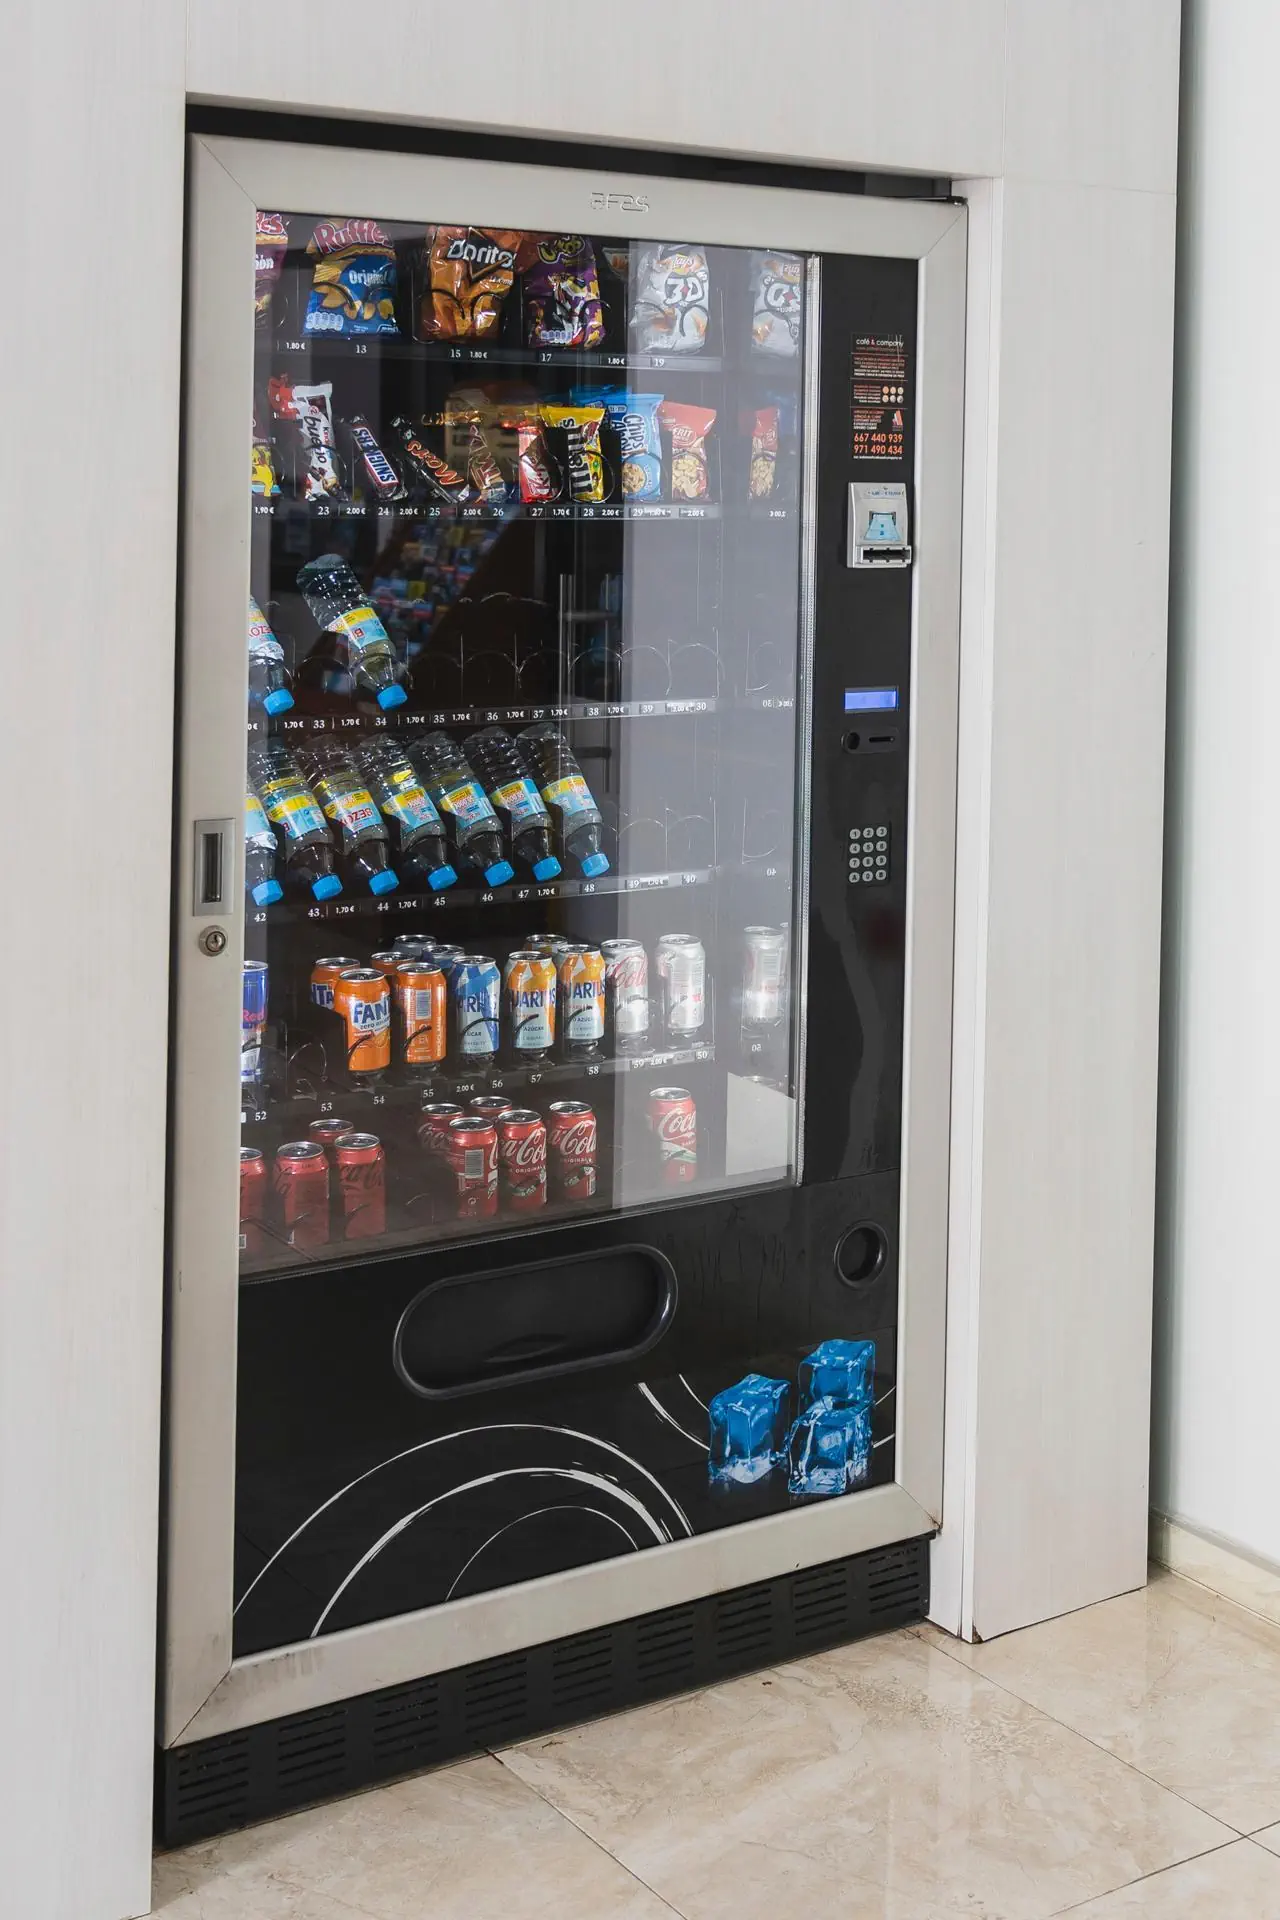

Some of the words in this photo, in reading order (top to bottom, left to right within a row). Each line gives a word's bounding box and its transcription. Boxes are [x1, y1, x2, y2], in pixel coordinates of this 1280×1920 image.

[313, 218, 393, 254] Ruffle
[446, 238, 515, 269] Dorito
[876, 340, 904, 348] company
[356, 345, 367, 354] 13
[450, 349, 461, 359] 15
[541, 353, 552, 362] 17
[654, 358, 664, 367] 19
[672, 427, 693, 438] FRIT
[303, 415, 327, 464] bueno
[854, 433, 869, 442] 667
[871, 433, 887, 443] 440
[888, 433, 903, 443] 939
[853, 444, 868, 453] 971
[870, 445, 886, 454] 490
[888, 445, 903, 455] 434
[352, 427, 397, 484] SNICERS
[406, 440, 465, 485] Mars
[318, 506, 329, 515] 23
[378, 507, 389, 516] 24
[430, 507, 441, 516] 25
[493, 507, 504, 516] 26
[532, 508, 543, 517] 27
[583, 508, 594, 517] 28
[633, 508, 643, 517] 29
[643, 703, 653, 713] 39
[695, 701, 707, 711] 30
[487, 712, 499, 721] 36
[533, 709, 545, 719] 37
[588, 707, 599, 716] 38
[313, 719, 325, 729] 33
[375, 717, 387, 727] 34
[433, 714, 445, 724] 35
[584, 883, 595, 893] 48
[482, 892, 493, 902] 46
[518, 889, 529, 899] 47
[377, 902, 389, 911] 44
[434, 897, 446, 906] 45
[254, 913, 266, 922] 42
[308, 908, 320, 917] 43
[353, 996, 391, 1024] FAN
[697, 1051, 708, 1060] 50
[633, 1059, 644, 1069] 59
[588, 1066, 599, 1076] 58
[531, 1074, 542, 1084] 57
[423, 1089, 434, 1098] 55
[492, 1079, 504, 1089] 56
[373, 1096, 385, 1105] 54
[321, 1103, 333, 1112] 53
[255, 1111, 267, 1121] 52
